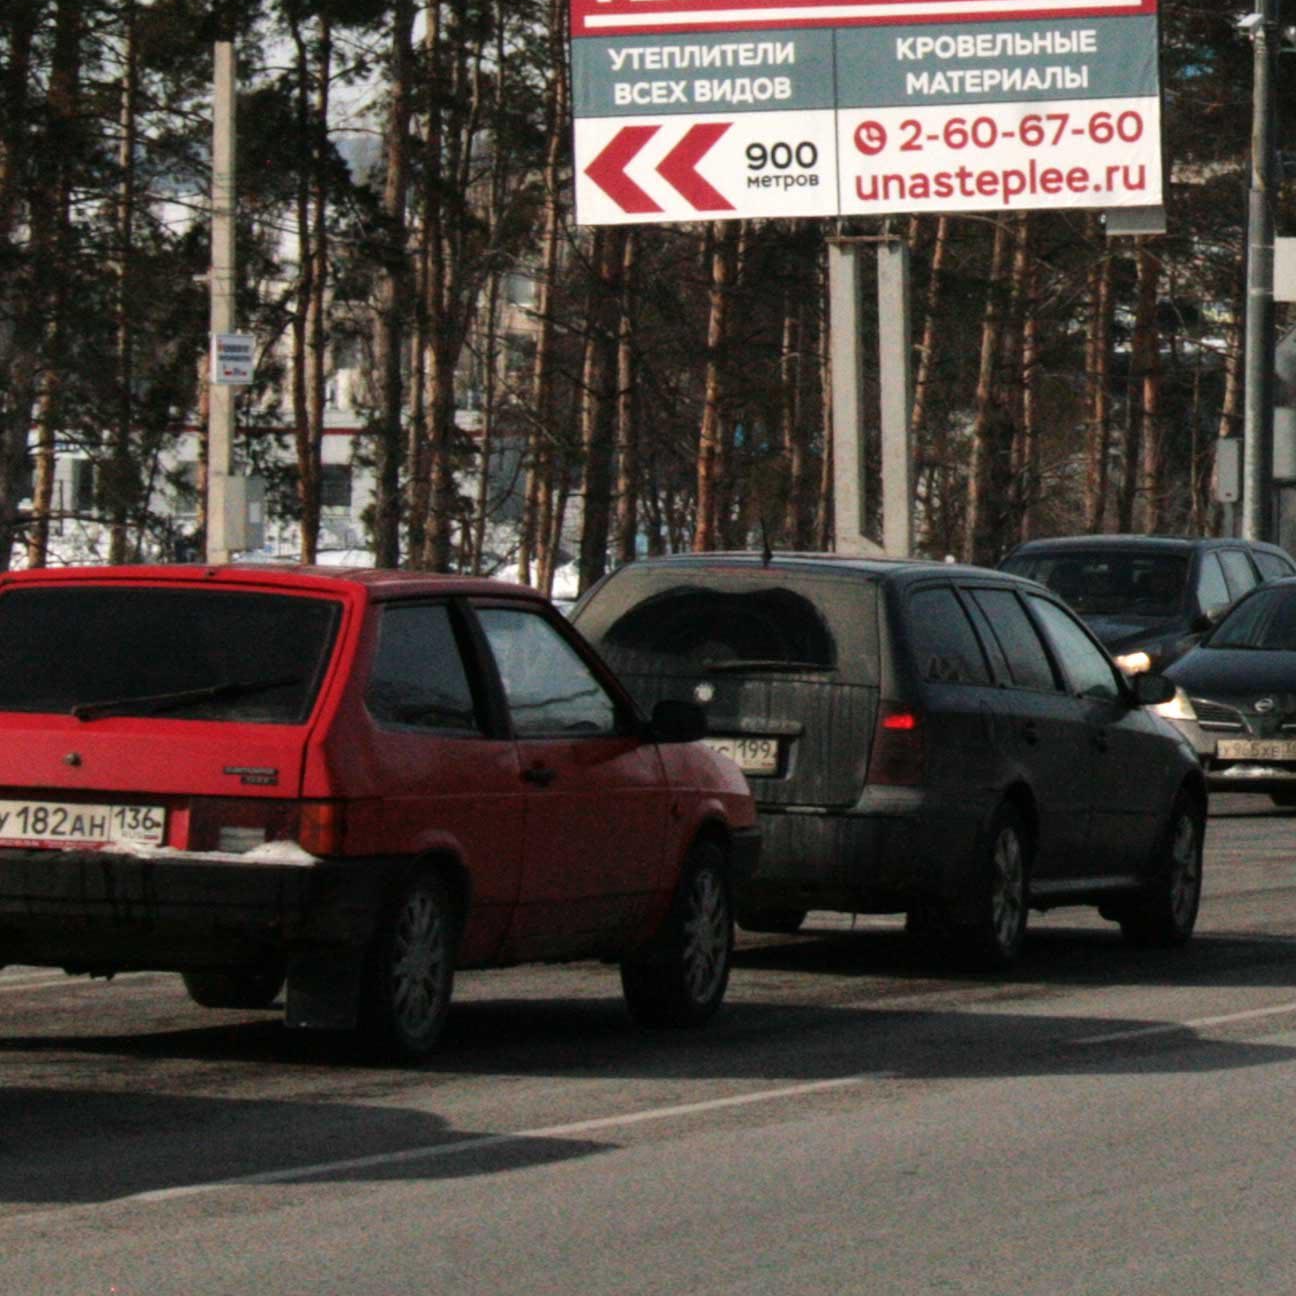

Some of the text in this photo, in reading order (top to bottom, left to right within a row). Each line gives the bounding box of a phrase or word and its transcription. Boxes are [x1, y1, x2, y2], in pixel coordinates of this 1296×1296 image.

[608, 42, 796, 72] УТЕПЛИТЕЛИ
[897, 30, 1098, 61] КРОВЕЛЬНЫЕ
[614, 77, 792, 106] ВСЕХ ВИДОВ
[906, 66, 1089, 96] МАТЕРИАЛЫ
[899, 111, 1143, 152] 2-60-67-60
[745, 141, 818, 170] 900
[747, 174, 819, 192] метров
[856, 161, 1145, 204] unasteplee.ru
[115, 807, 155, 831] 136
